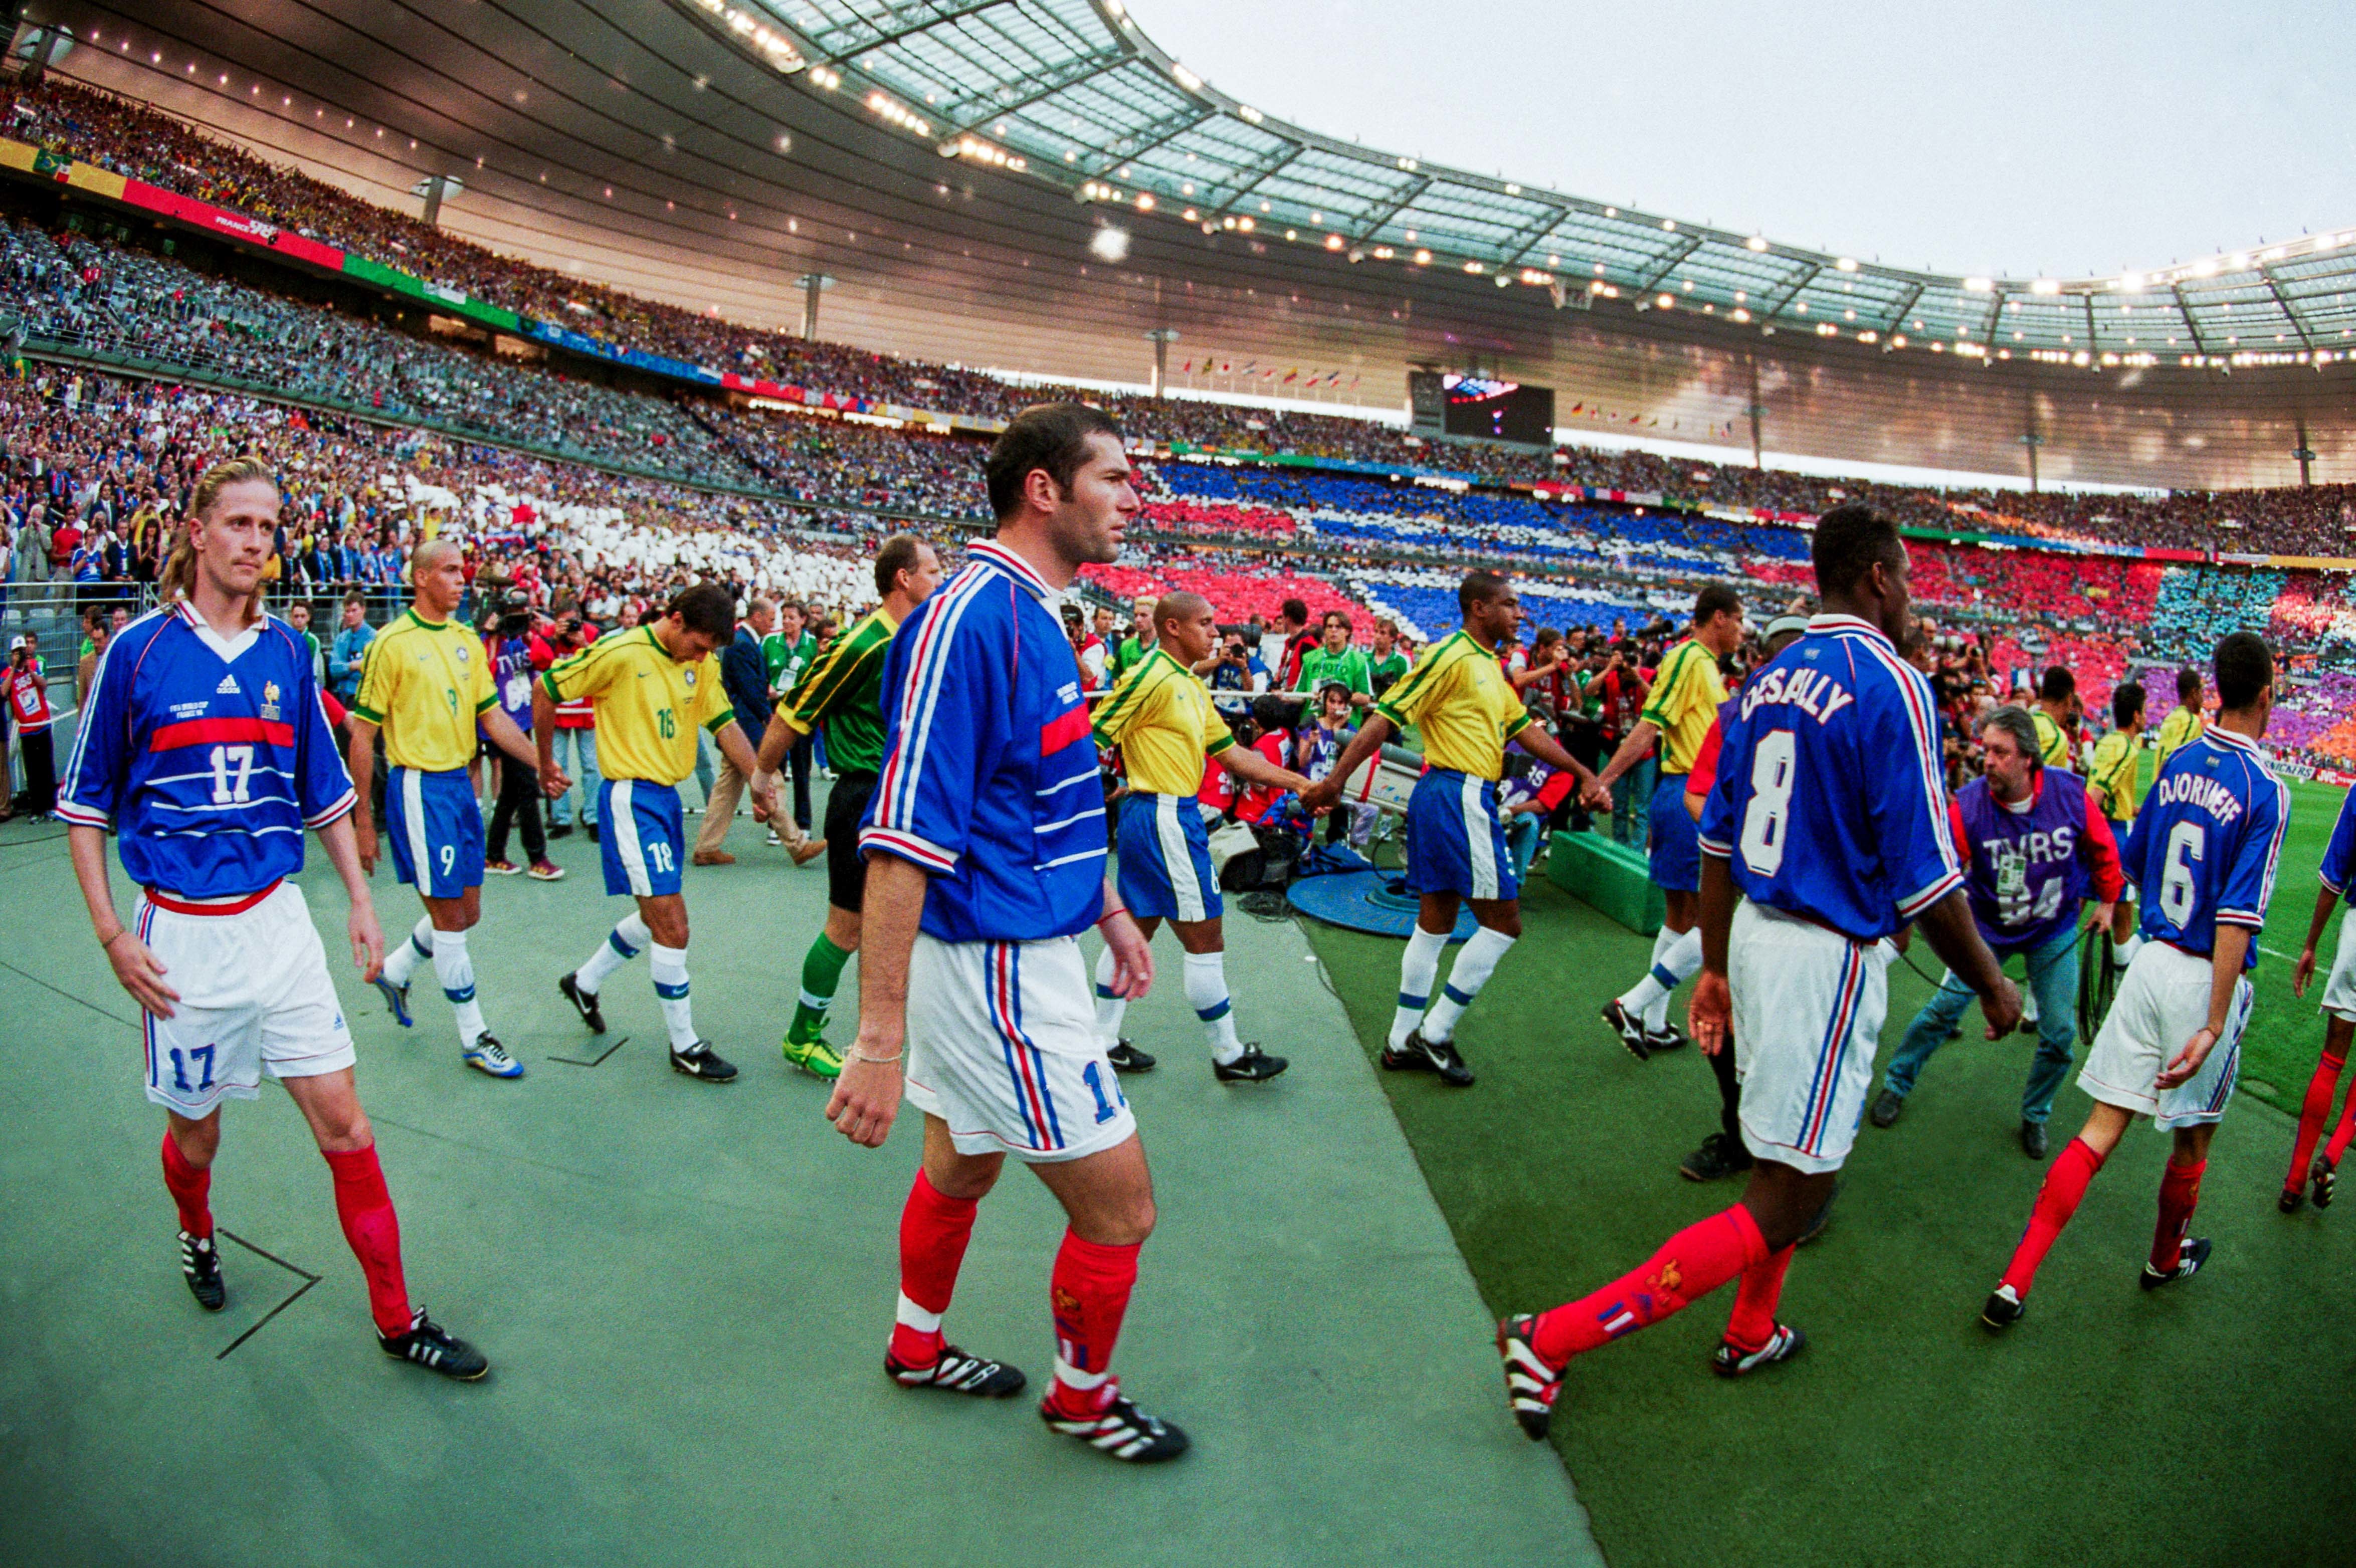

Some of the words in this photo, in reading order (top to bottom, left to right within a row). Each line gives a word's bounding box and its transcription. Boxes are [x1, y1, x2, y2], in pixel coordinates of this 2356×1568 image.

[216, 216, 249, 233] FRANCE
[250, 220, 276, 239] 98
[447, 688, 458, 717] 9
[210, 745, 254, 803] 17
[2316, 769, 2337, 784] JVC
[1739, 728, 1796, 878] 8
[441, 845, 455, 876] 9
[647, 842, 675, 873] 18
[1983, 826, 2074, 870] TVRS
[1210, 864, 1221, 894] 6
[2159, 820, 2205, 930] 6
[169, 1043, 216, 1093] 17
[1082, 1060, 1126, 1125] 1
